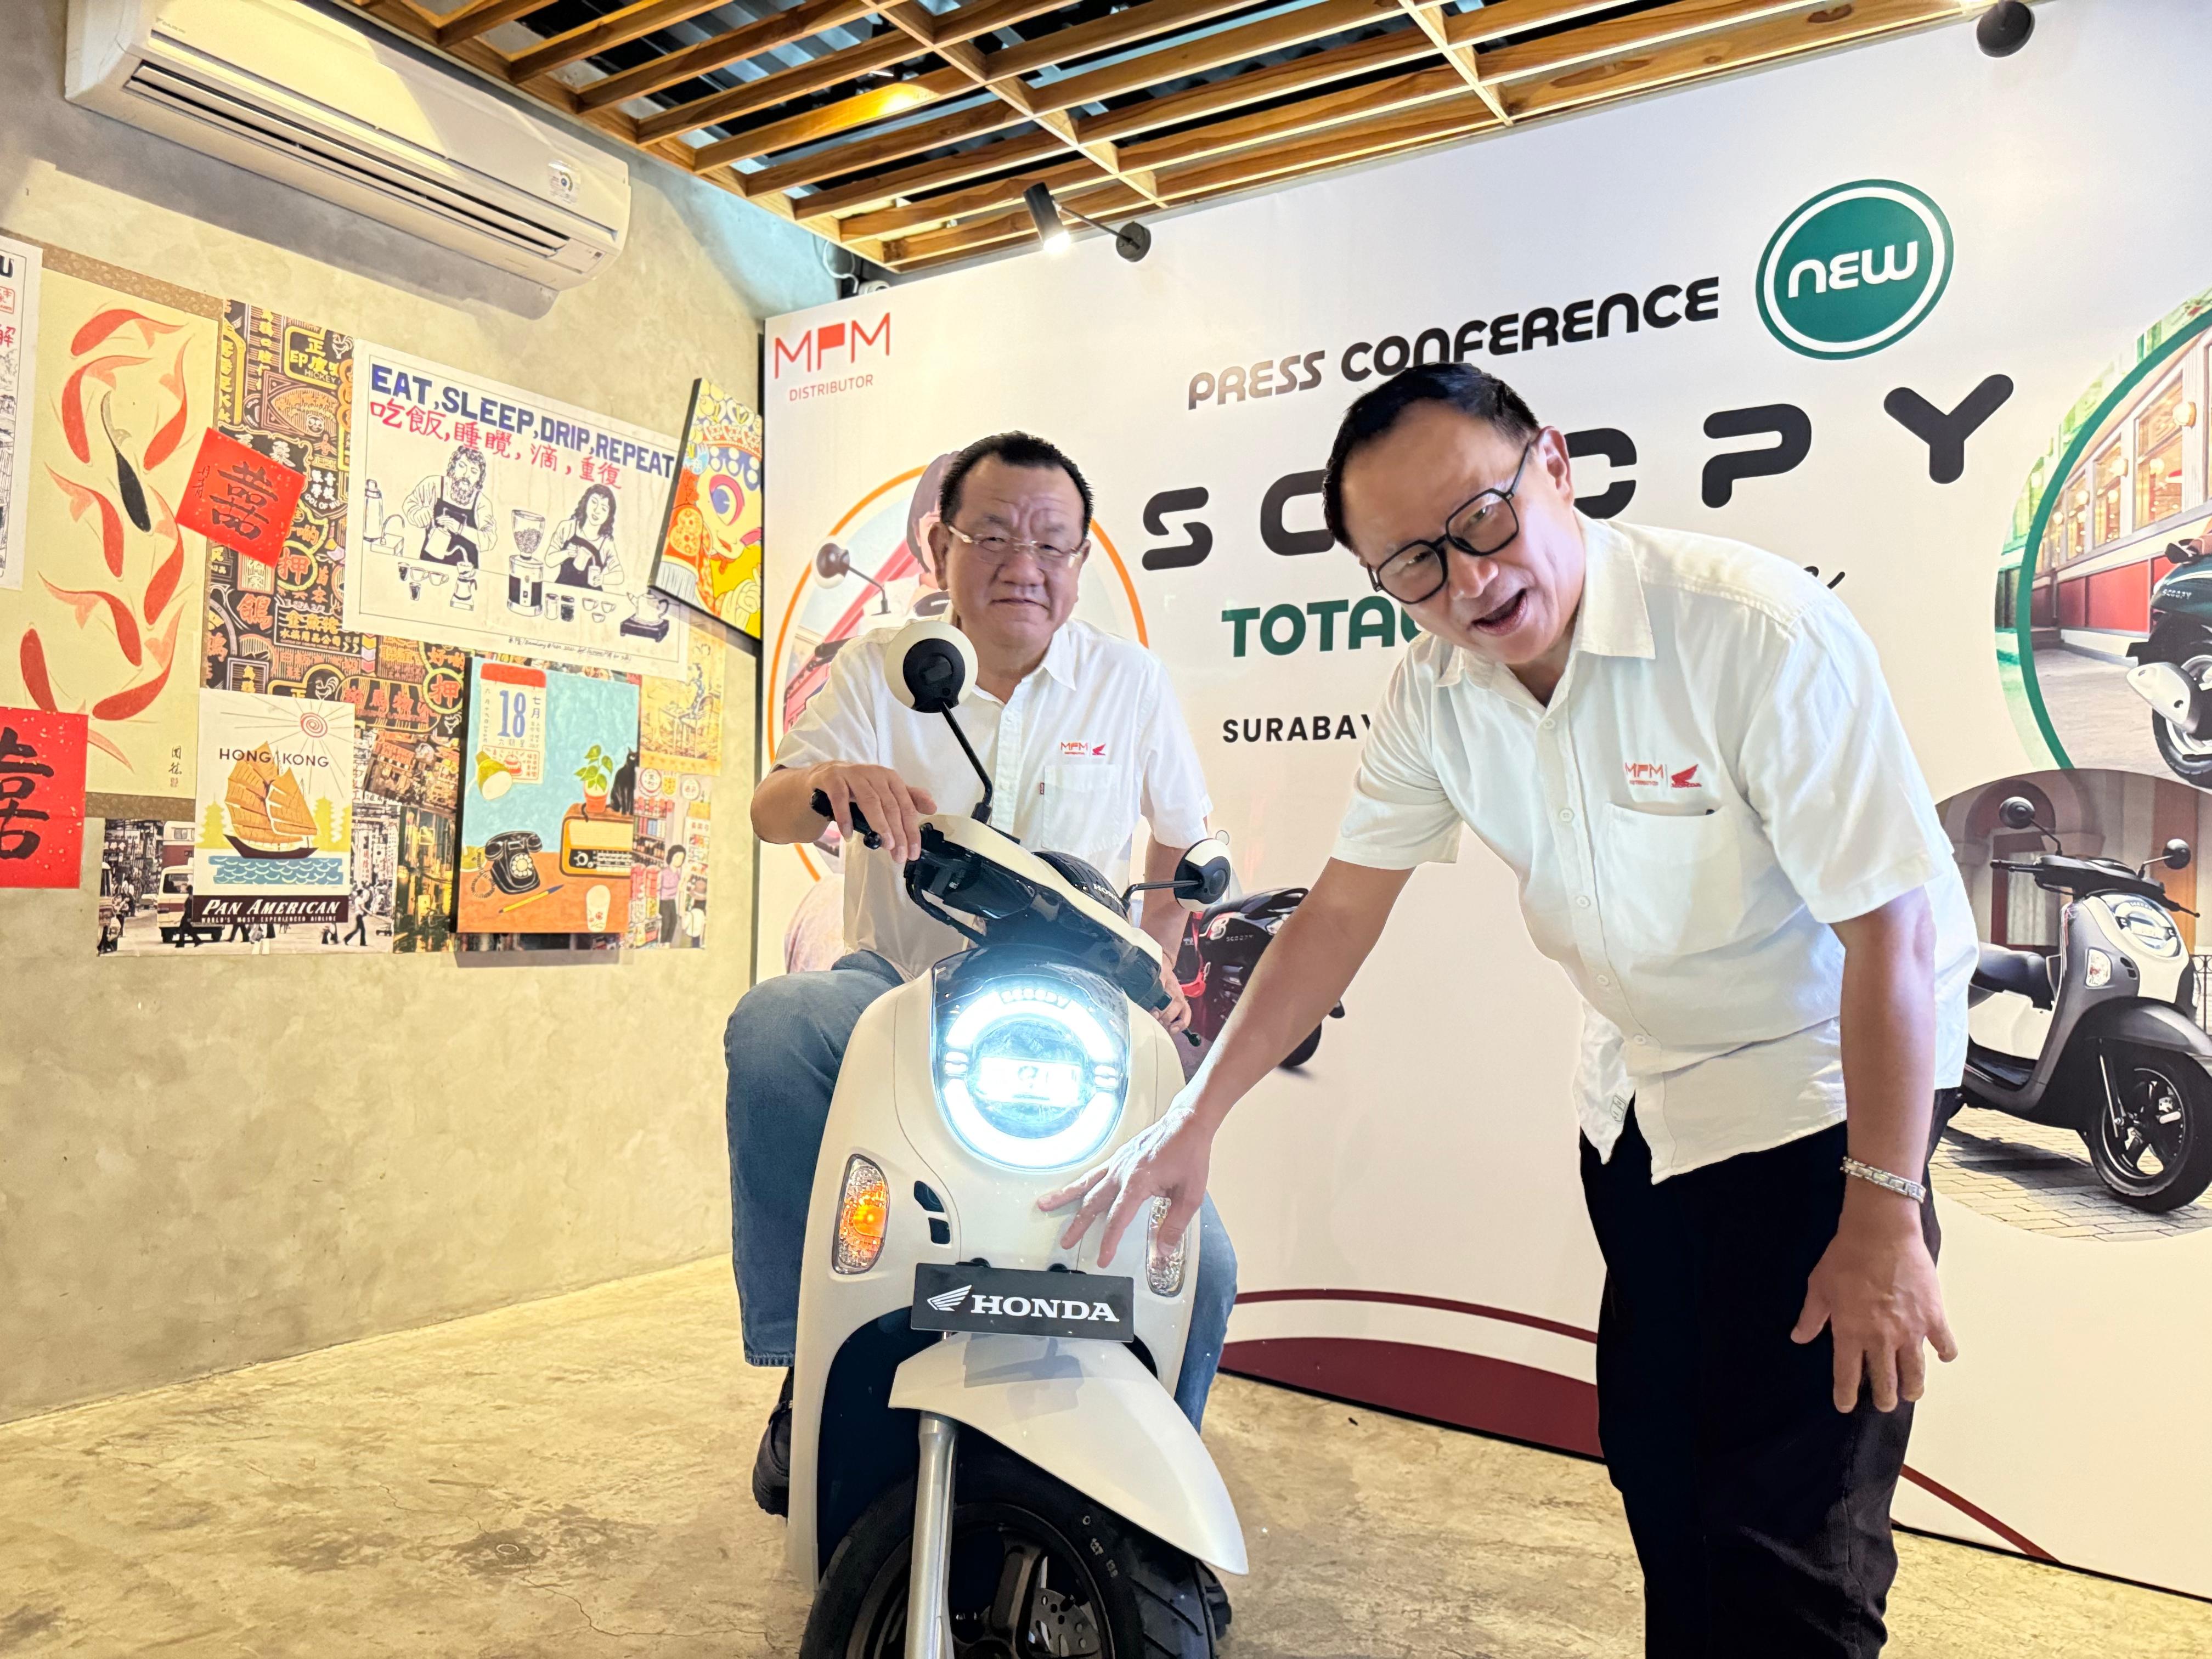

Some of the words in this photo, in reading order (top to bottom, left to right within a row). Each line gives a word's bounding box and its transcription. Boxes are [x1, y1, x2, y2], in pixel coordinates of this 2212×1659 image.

[1787, 240, 1918, 298] NEW
[774, 312, 890, 380] MPM
[1188, 349, 1326, 410] PRESS
[1340, 276, 1720, 382] CONFERENCE
[789, 373, 874, 402] DISTRIBUTOR
[595, 433, 676, 479] REPEAT
[497, 690, 526, 738] 18
[219, 748, 272, 763] HONG
[283, 753, 329, 767] KONG
[1625, 762, 1664, 778] MPM
[201, 899, 243, 915] PAN
[246, 899, 341, 915] AMERICAN
[970, 1295, 1120, 1322] HONDA
